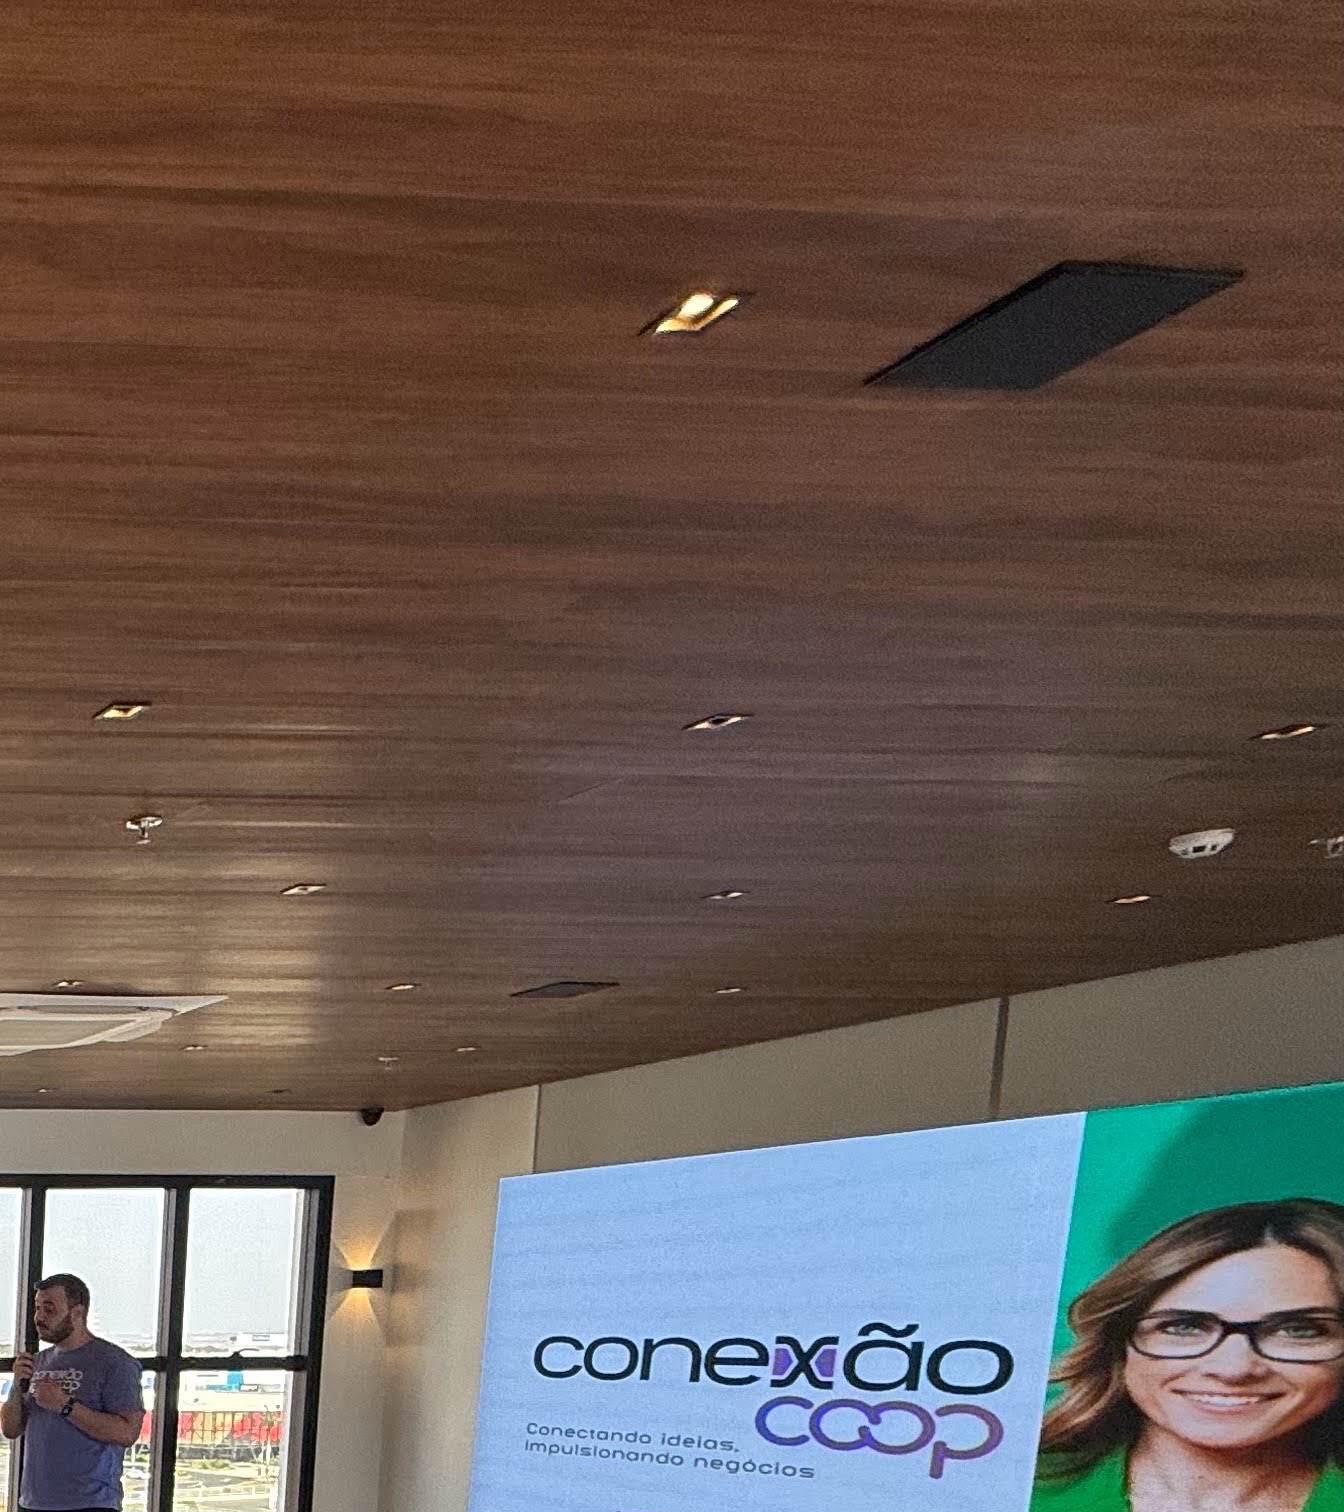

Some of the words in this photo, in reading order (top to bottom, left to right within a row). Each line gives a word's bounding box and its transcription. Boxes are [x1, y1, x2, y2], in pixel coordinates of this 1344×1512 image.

[533, 1322, 1014, 1395] conexão
[525, 1440, 684, 1465] impulsionando
[694, 1457, 815, 1479] negócios
[526, 1422, 652, 1444] Conectando
[755, 1396, 1004, 1479] coop
